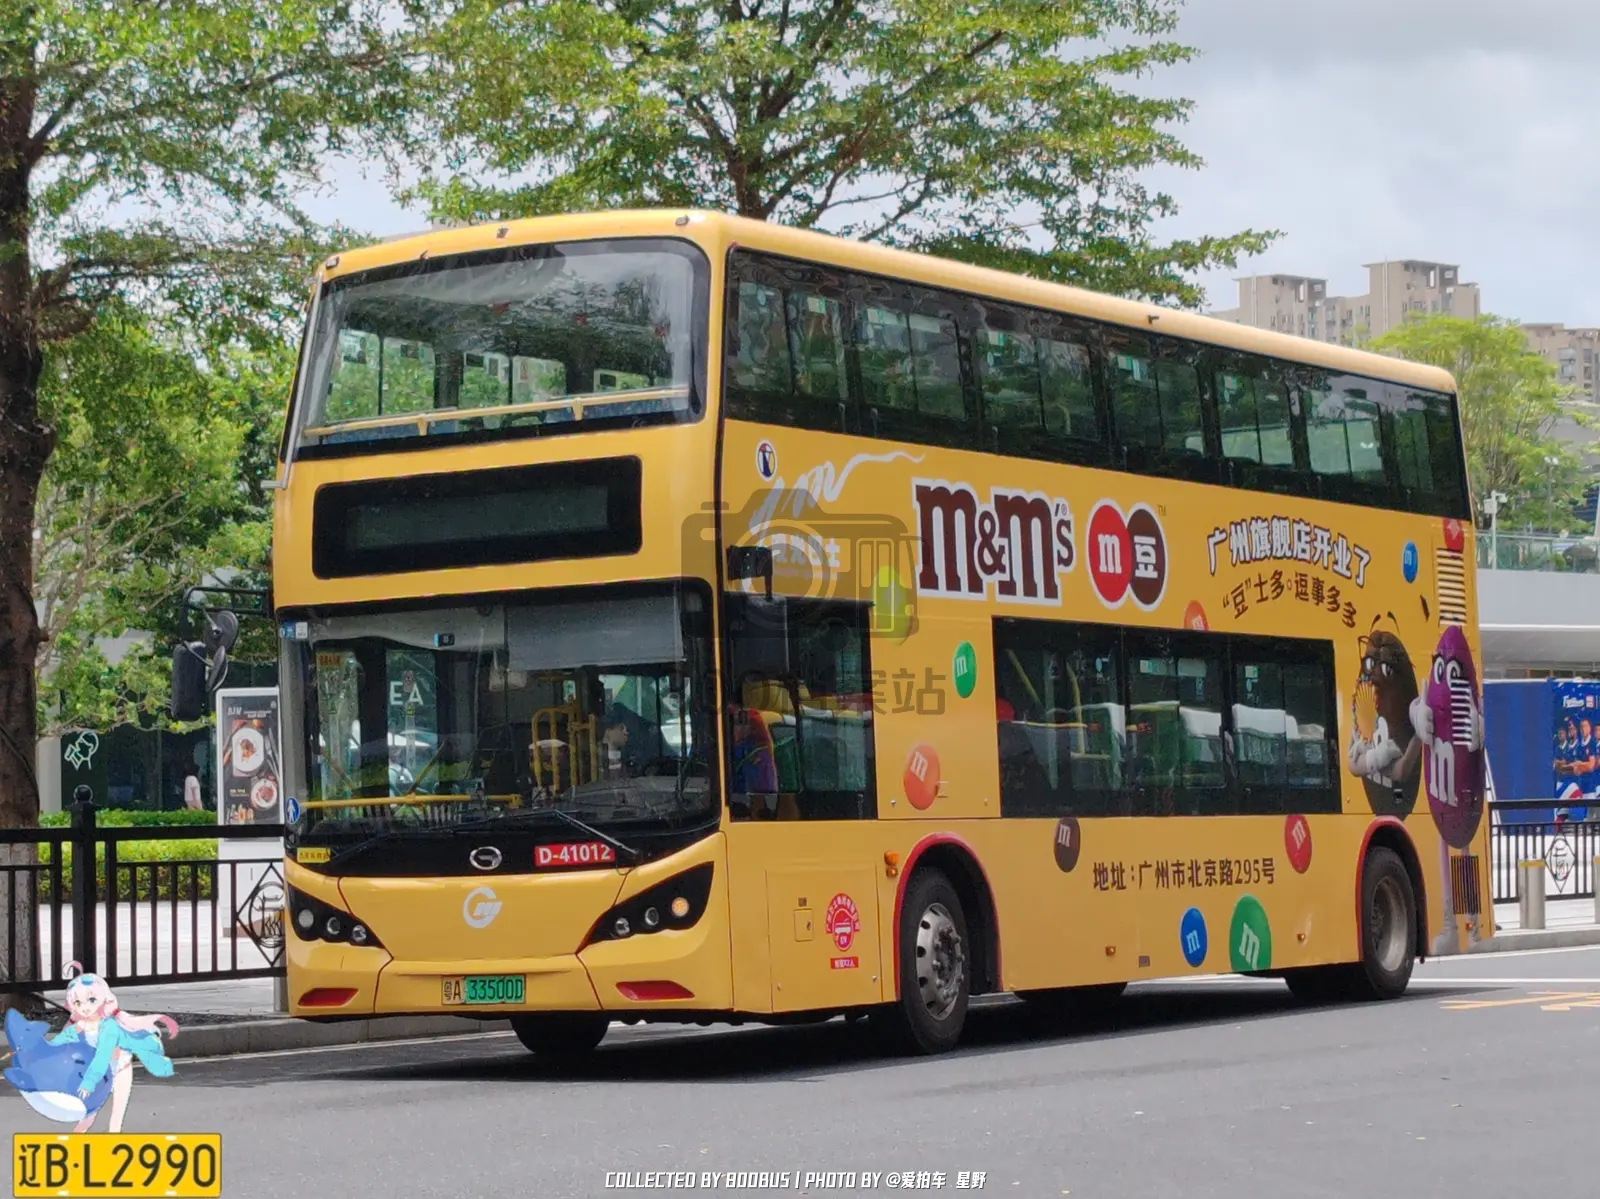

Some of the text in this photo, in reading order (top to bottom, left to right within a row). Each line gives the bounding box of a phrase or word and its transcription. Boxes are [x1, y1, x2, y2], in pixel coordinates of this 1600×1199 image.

[1207, 516, 1371, 588] 广州旗舰店开业了
[539, 843, 612, 864] D-41012
